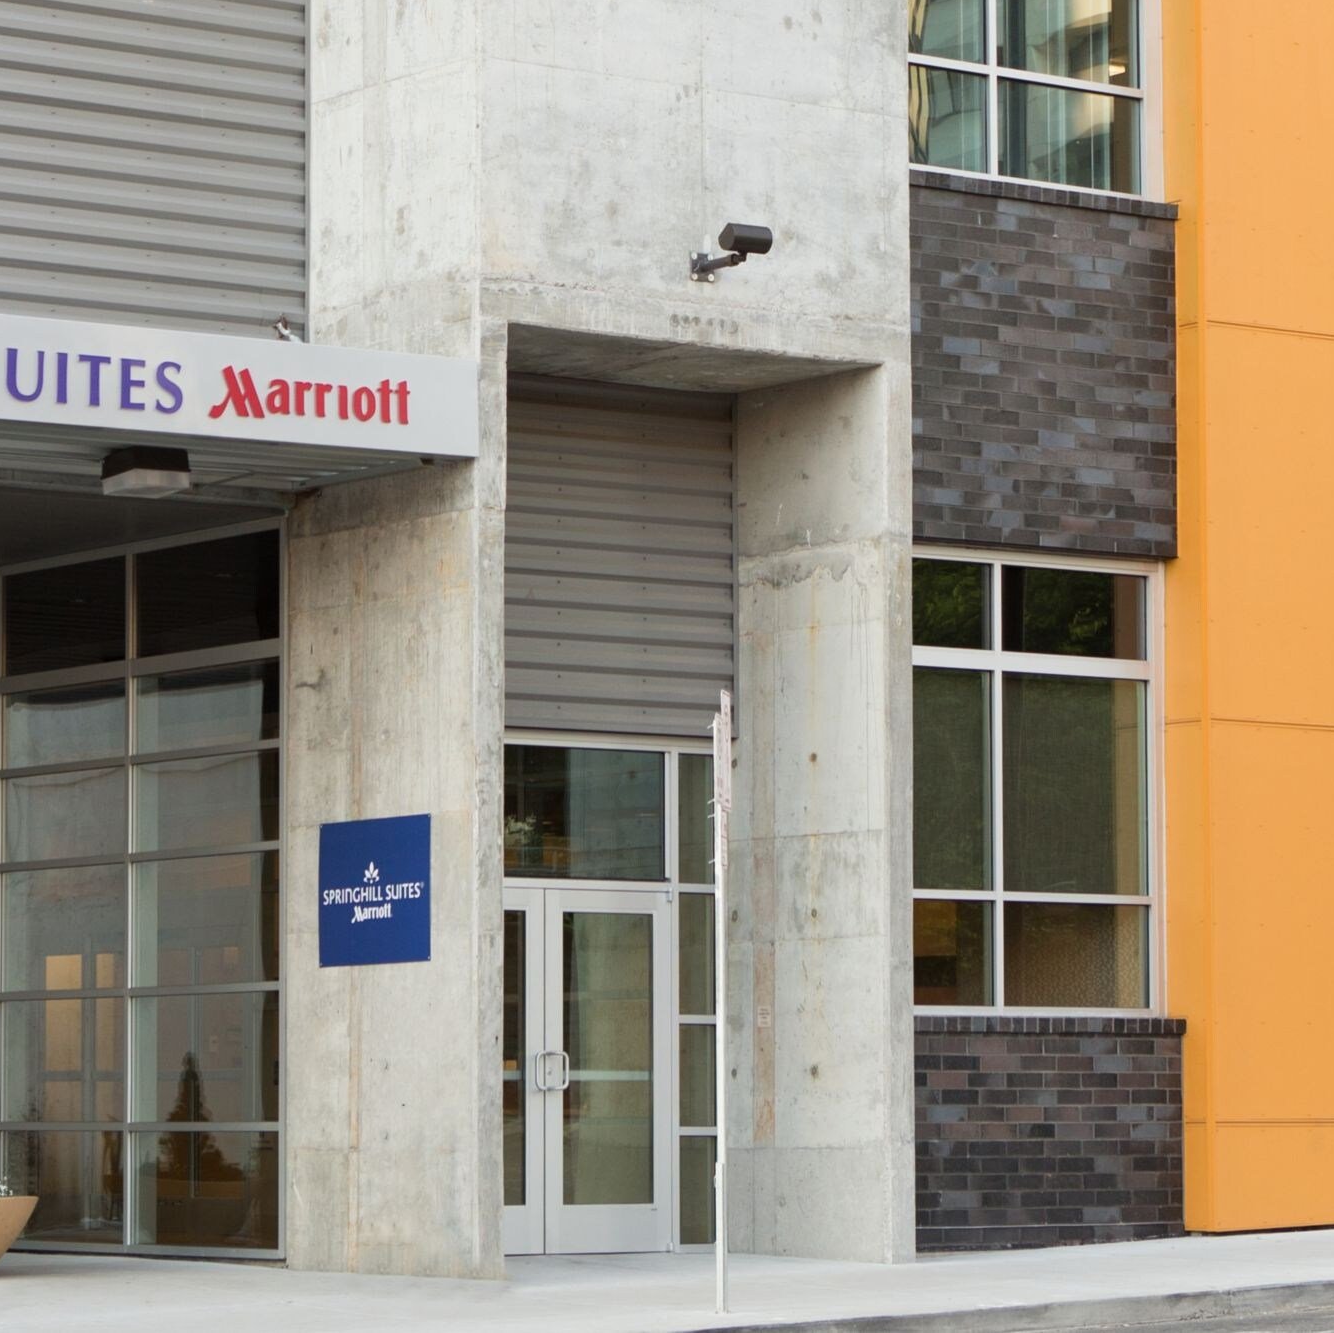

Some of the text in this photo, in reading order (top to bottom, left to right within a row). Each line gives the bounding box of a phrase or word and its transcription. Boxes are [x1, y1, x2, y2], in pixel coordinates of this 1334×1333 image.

[208, 365, 410, 426] Marriott
[323, 882, 421, 905] SPRINGHILL SUITES
[351, 902, 392, 924] Marriott
